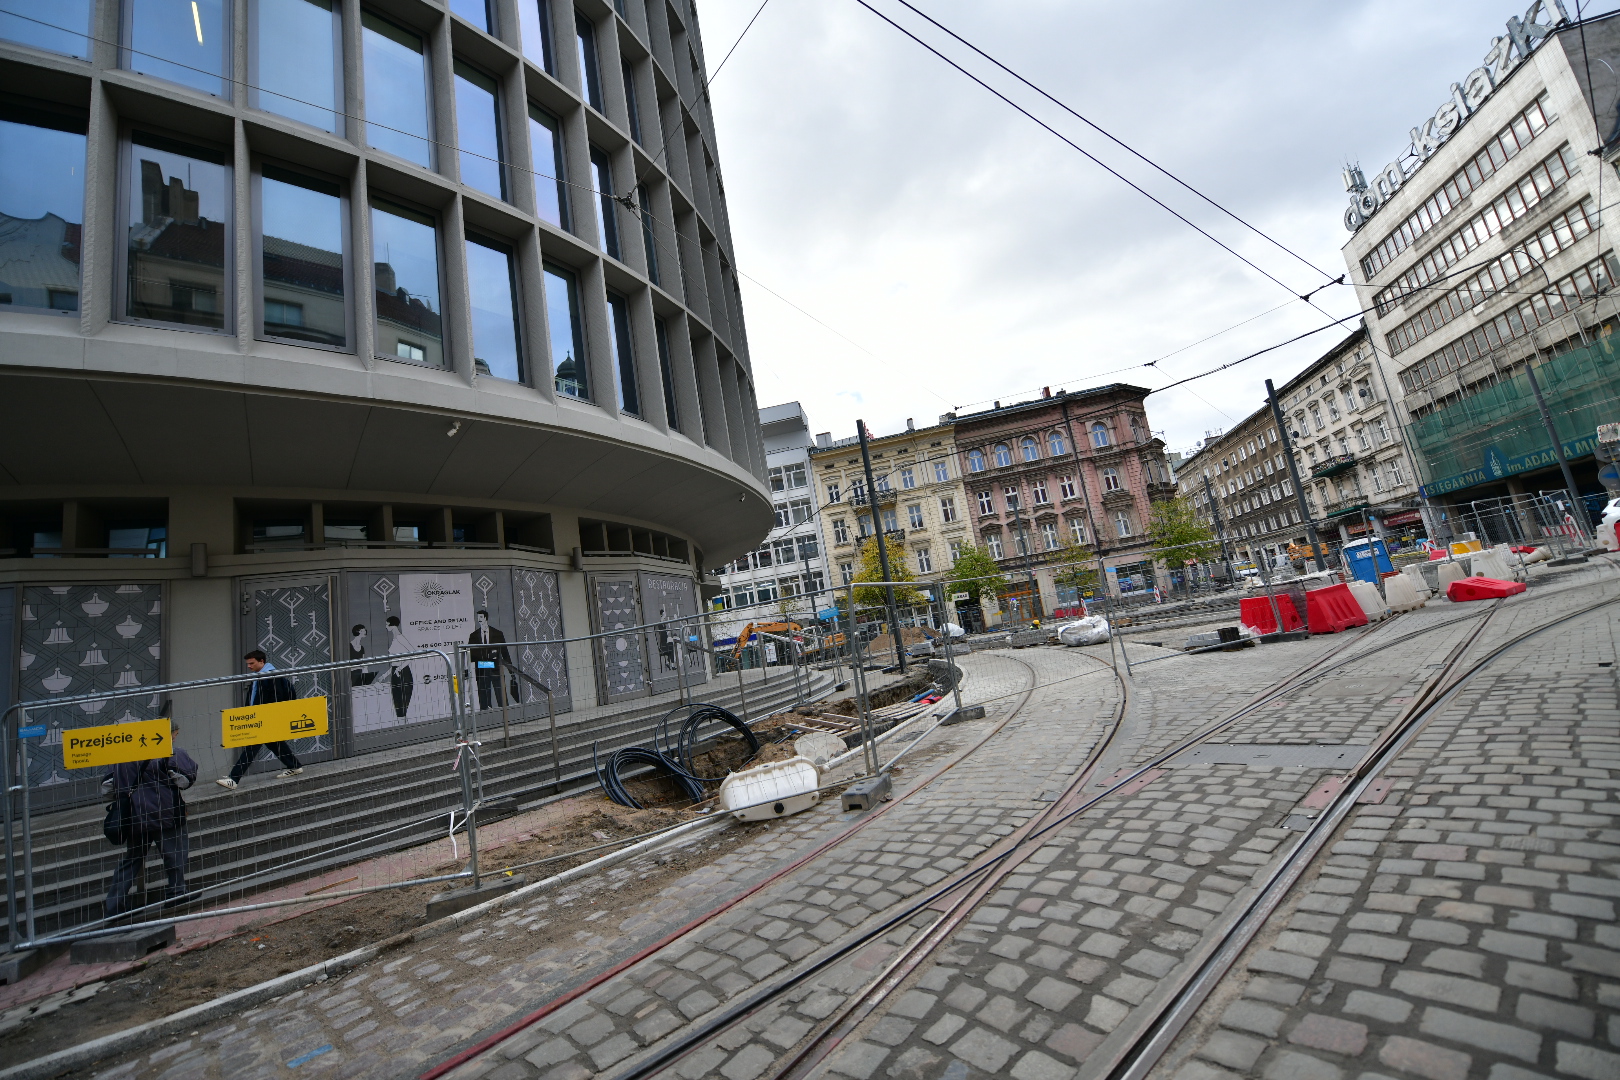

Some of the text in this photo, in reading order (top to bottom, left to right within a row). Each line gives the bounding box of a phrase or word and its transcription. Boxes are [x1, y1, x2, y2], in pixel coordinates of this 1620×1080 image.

[1343, 160, 1407, 232] dom
[229, 712, 256, 722] Uwaga!
[229, 720, 263, 731] Tramwaj!
[70, 732, 133, 749] Przejście
